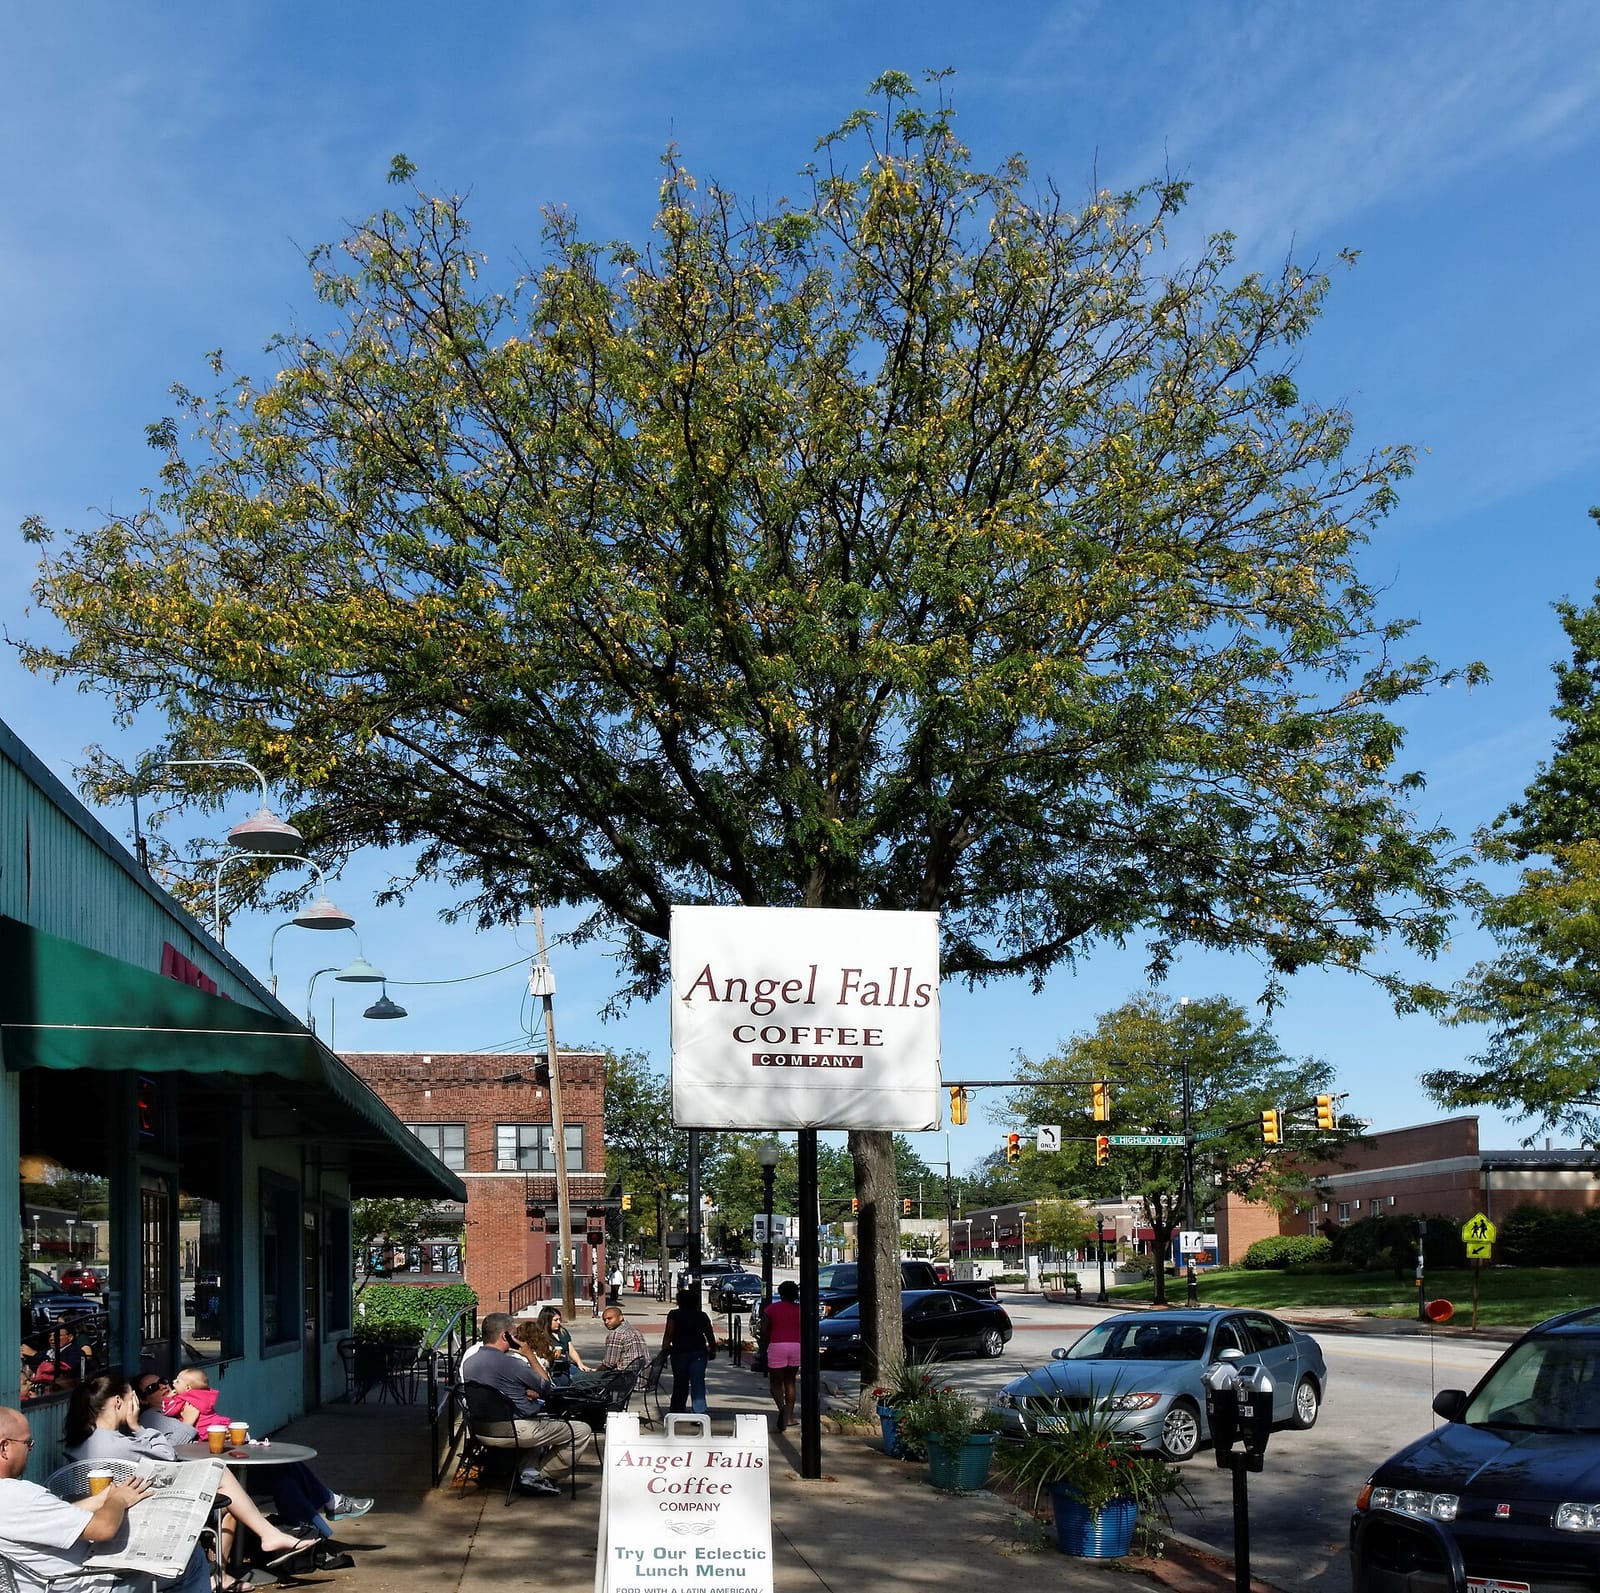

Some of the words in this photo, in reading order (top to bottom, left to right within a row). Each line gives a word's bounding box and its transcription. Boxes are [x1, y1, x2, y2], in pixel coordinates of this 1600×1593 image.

[682, 964, 818, 1016] Angel
[836, 967, 932, 1008] Falls
[733, 1025, 884, 1046] COFFEE
[760, 1054, 856, 1067] COMPANY
[1109, 1136, 1116, 1144] S
[1120, 1136, 1163, 1144] HIGHLAND
[1166, 1136, 1185, 1144] AVE
[616, 1450, 693, 1474] Angel
[703, 1451, 764, 1468] Falls
[647, 1476, 733, 1495] Coffee
[659, 1502, 721, 1512] COMPANY
[615, 1547, 645, 1562] Try
[653, 1547, 687, 1560] Our
[695, 1547, 766, 1560] Eclectic
[635, 1564, 689, 1577] Lunch
[696, 1564, 746, 1577] Menu
